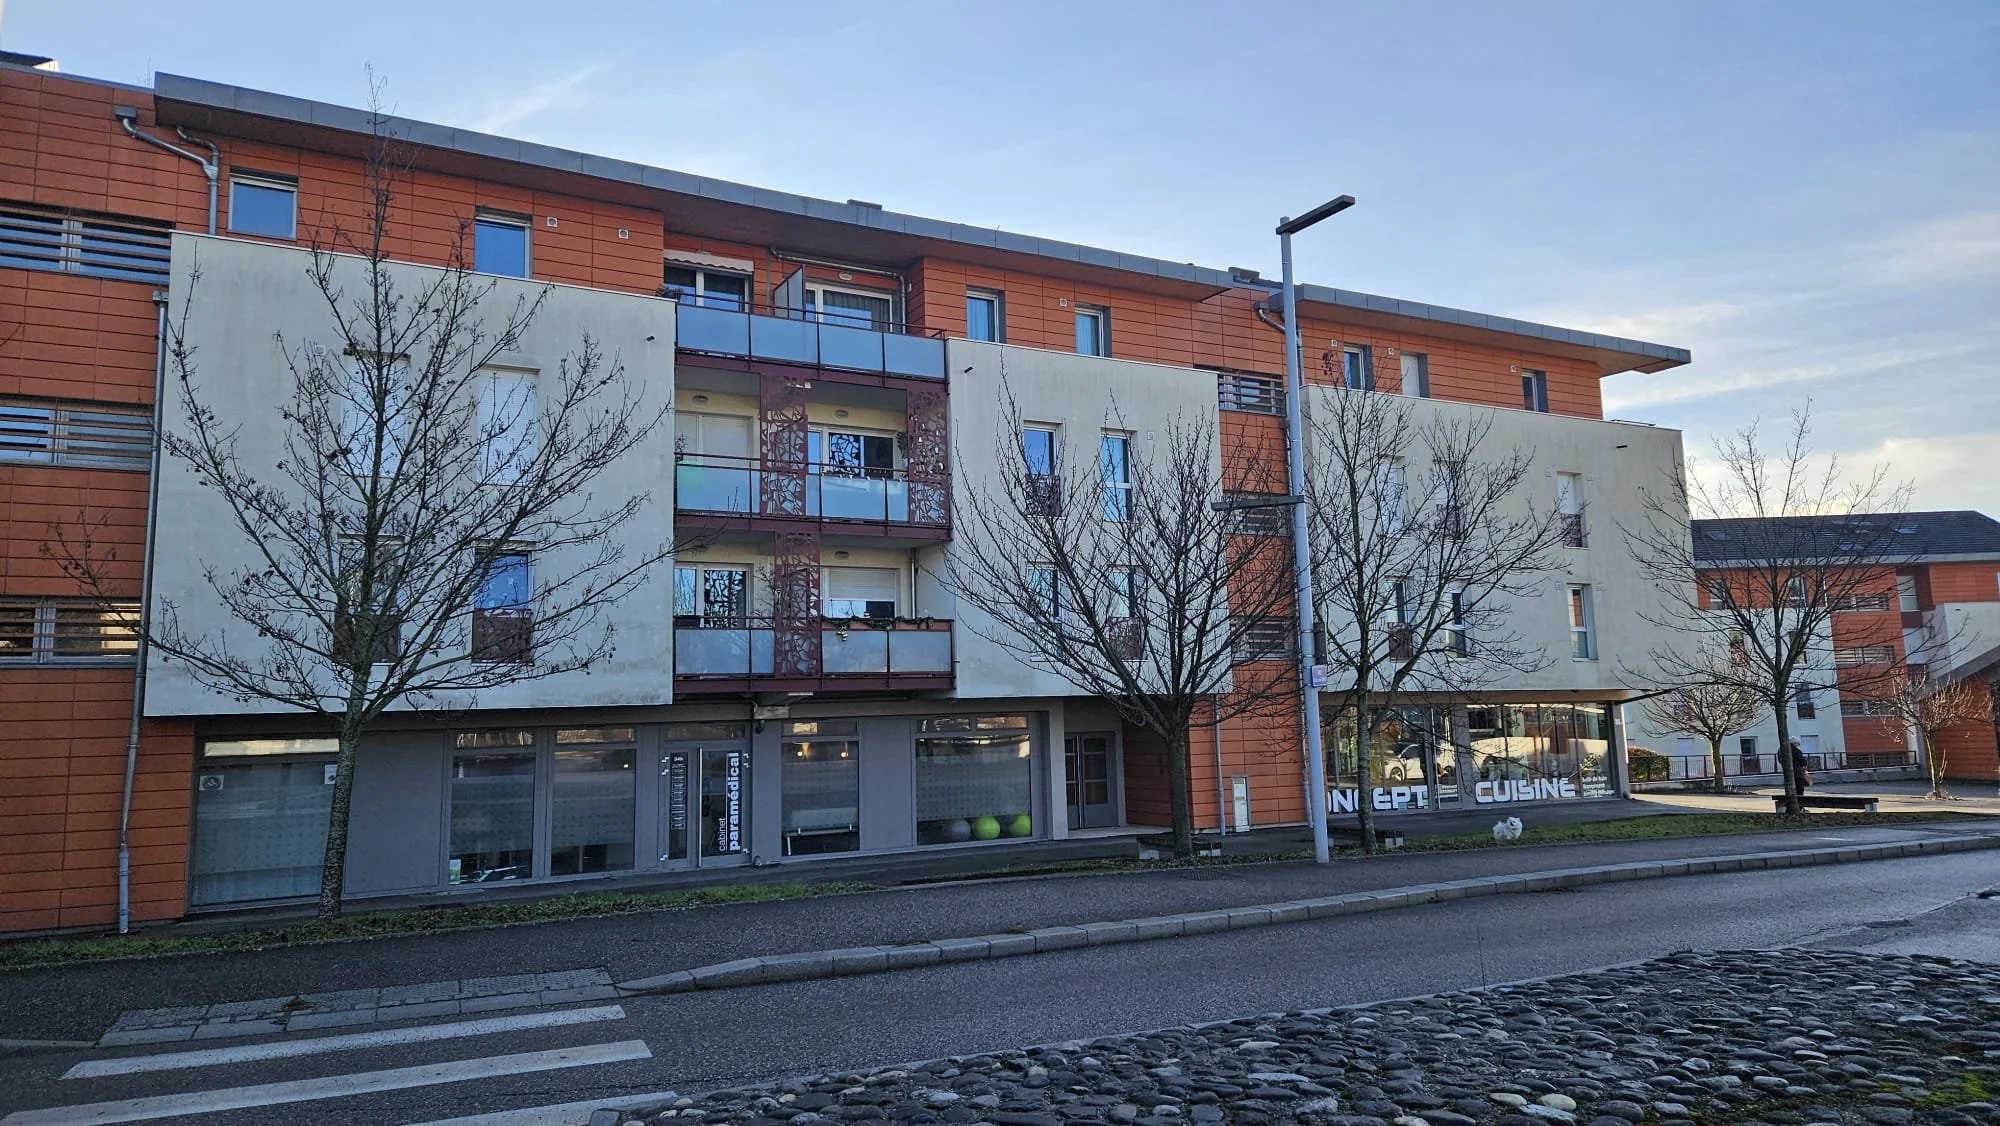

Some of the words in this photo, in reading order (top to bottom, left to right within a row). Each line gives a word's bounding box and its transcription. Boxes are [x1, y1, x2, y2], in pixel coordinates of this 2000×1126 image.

[728, 752, 740, 851] paramédical
[1475, 777, 1576, 803] CUISINE
[718, 817, 726, 851] cabinet
